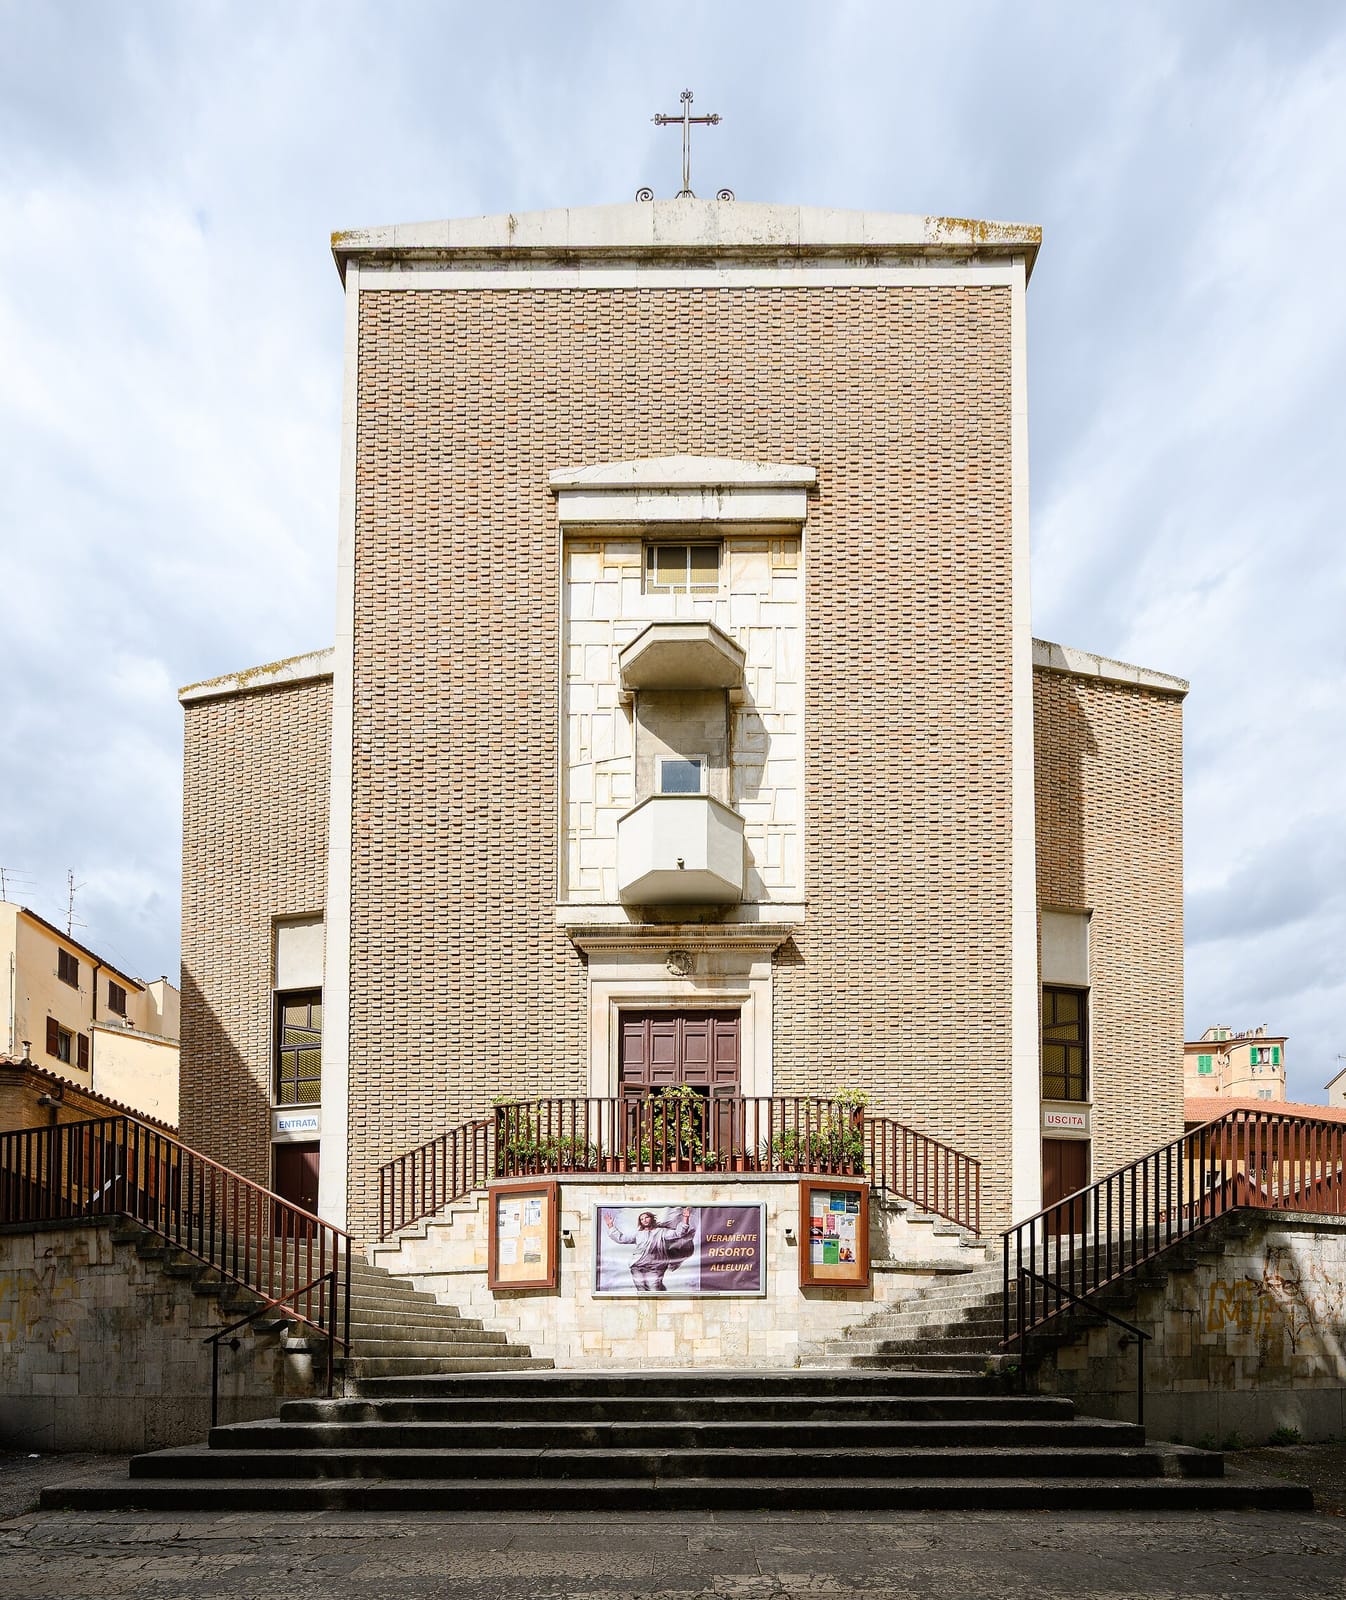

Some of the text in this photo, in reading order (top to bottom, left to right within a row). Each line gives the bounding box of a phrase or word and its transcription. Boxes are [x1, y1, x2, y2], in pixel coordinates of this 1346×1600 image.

[279, 1119, 317, 1129] ENTRATA
[1047, 1115, 1083, 1125] USCITA
[706, 1234, 757, 1242] VERAMENTE
[708, 1247, 755, 1257] RISORTO
[710, 1263, 753, 1272] ALLELUIA!
